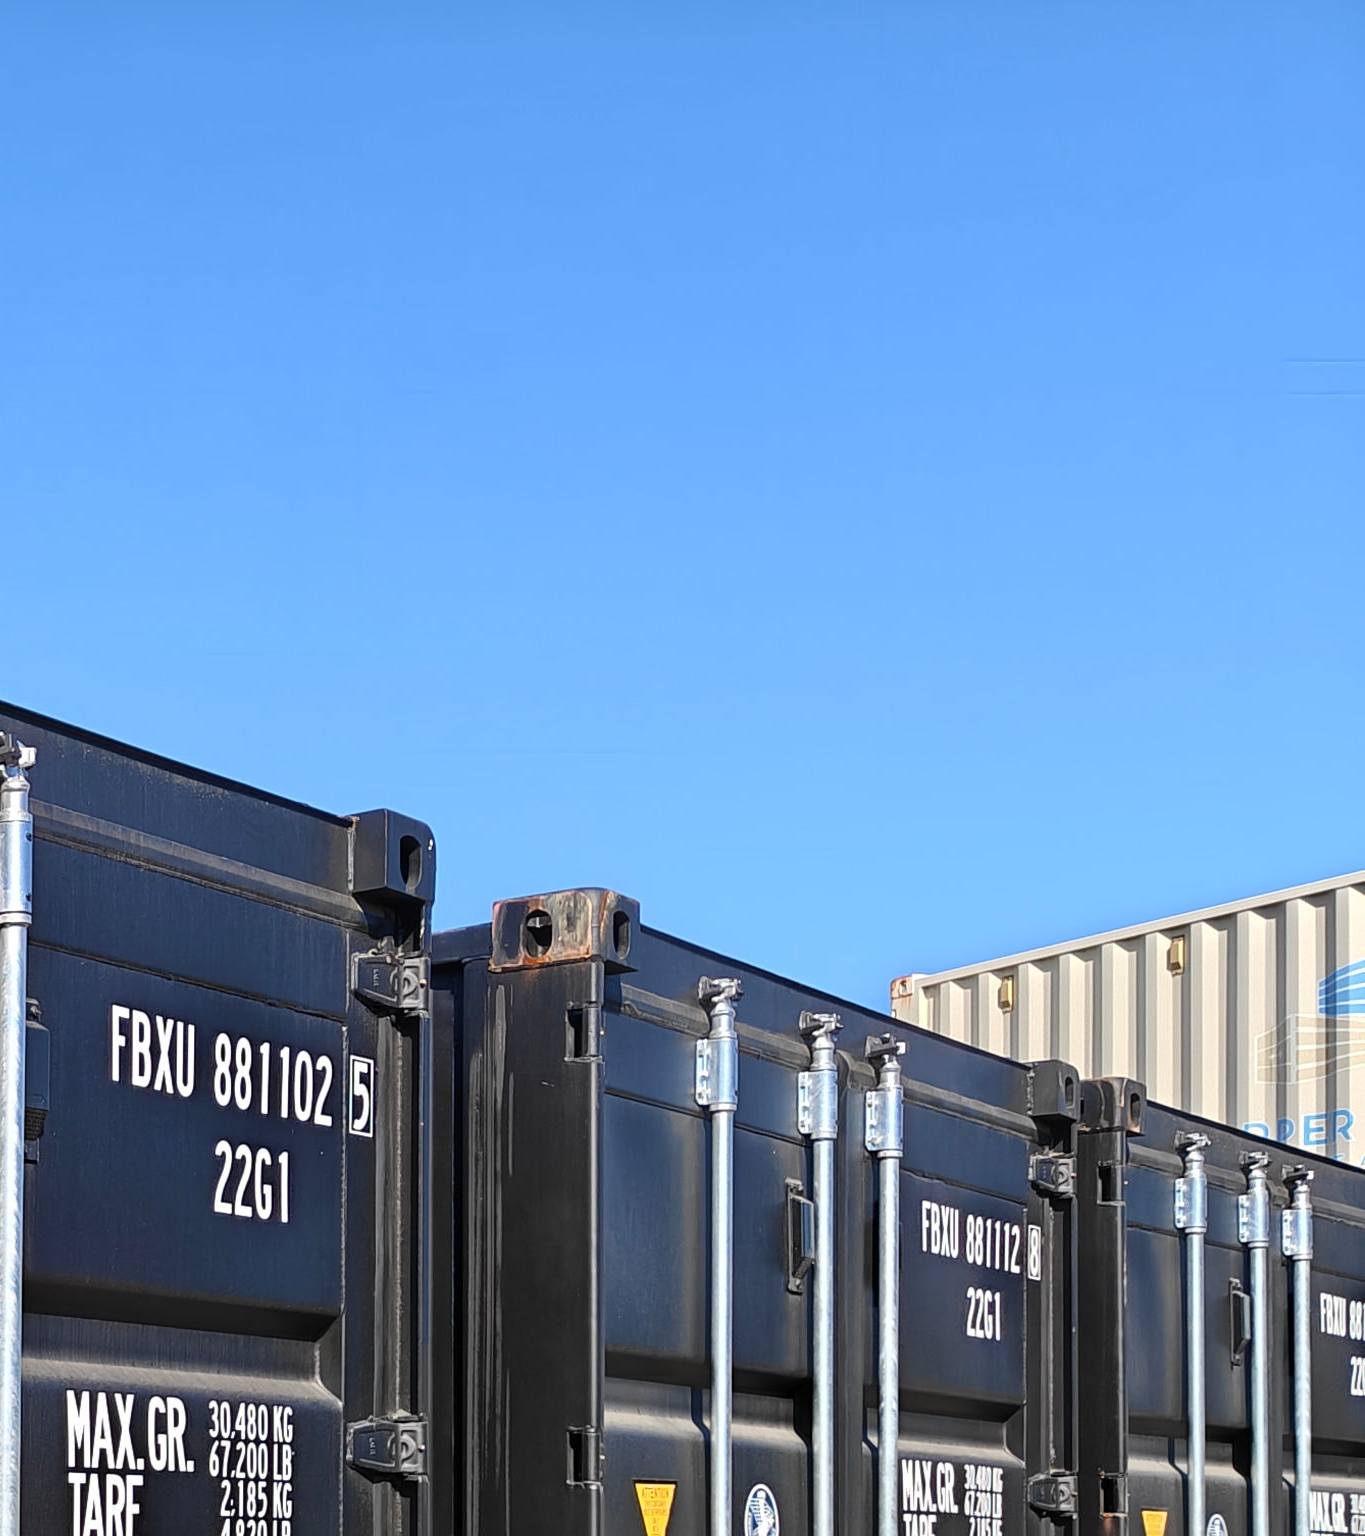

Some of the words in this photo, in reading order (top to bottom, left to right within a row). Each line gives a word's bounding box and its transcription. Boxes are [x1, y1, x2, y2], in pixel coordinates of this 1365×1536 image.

[111, 1004, 196, 1098] FBXU
[213, 1032, 333, 1127] 881102
[351, 1058, 373, 1134] 5
[213, 1139, 289, 1224] 22G1
[921, 1199, 959, 1259] FBXU
[965, 1214, 1021, 1274] 881112
[1029, 1228, 1041, 1278] 8
[966, 1286, 1001, 1341] 22G1
[1320, 1292, 1347, 1338] FBXU
[208, 1400, 269, 1441] 30,480
[273, 1405, 294, 1444] KG
[208, 1440, 269, 1480] 67,200
[272, 1443, 293, 1482] LB
[220, 1479, 268, 1518] 2,185
[272, 1481, 293, 1519] KG
